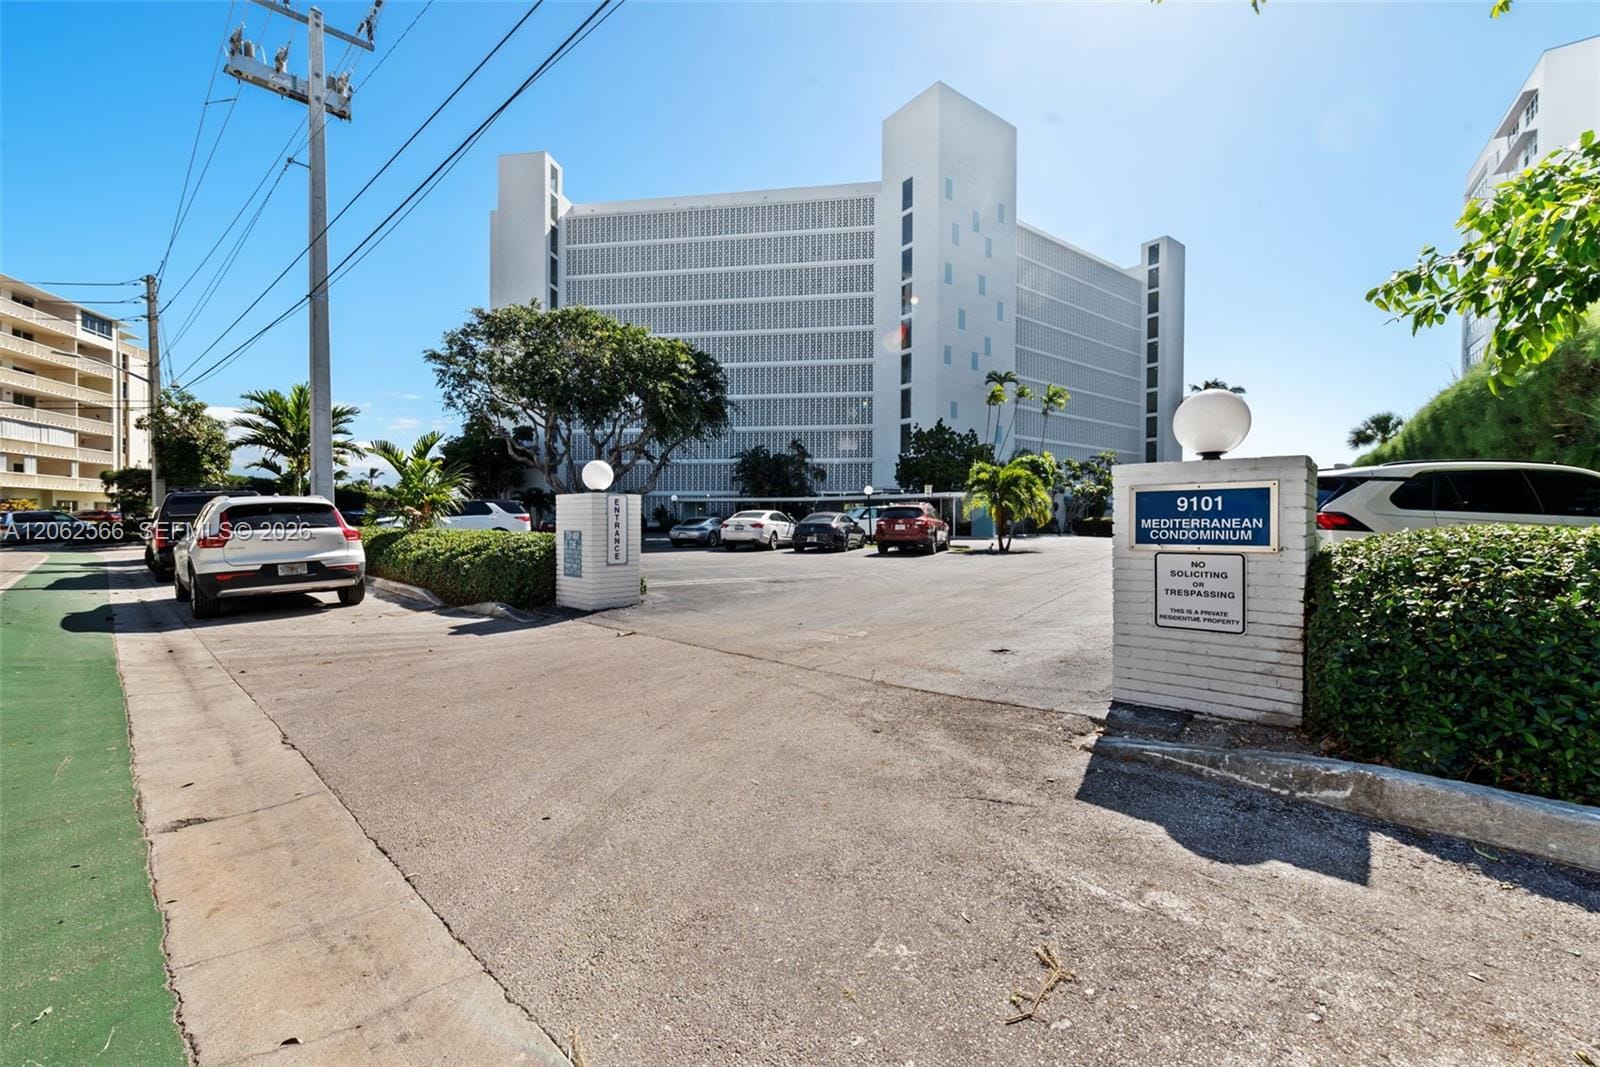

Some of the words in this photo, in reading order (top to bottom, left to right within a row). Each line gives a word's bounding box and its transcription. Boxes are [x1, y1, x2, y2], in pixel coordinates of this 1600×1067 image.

[1176, 496, 1224, 512] 9101
[1141, 518, 1263, 529] MEDITERRANEAN
[1150, 530, 1252, 540] CONDOMINIUM
[1170, 570, 1228, 580] SOLICITING
[1164, 588, 1236, 600] TRESPASSING
[1202, 616, 1240, 626] PROPERTY
